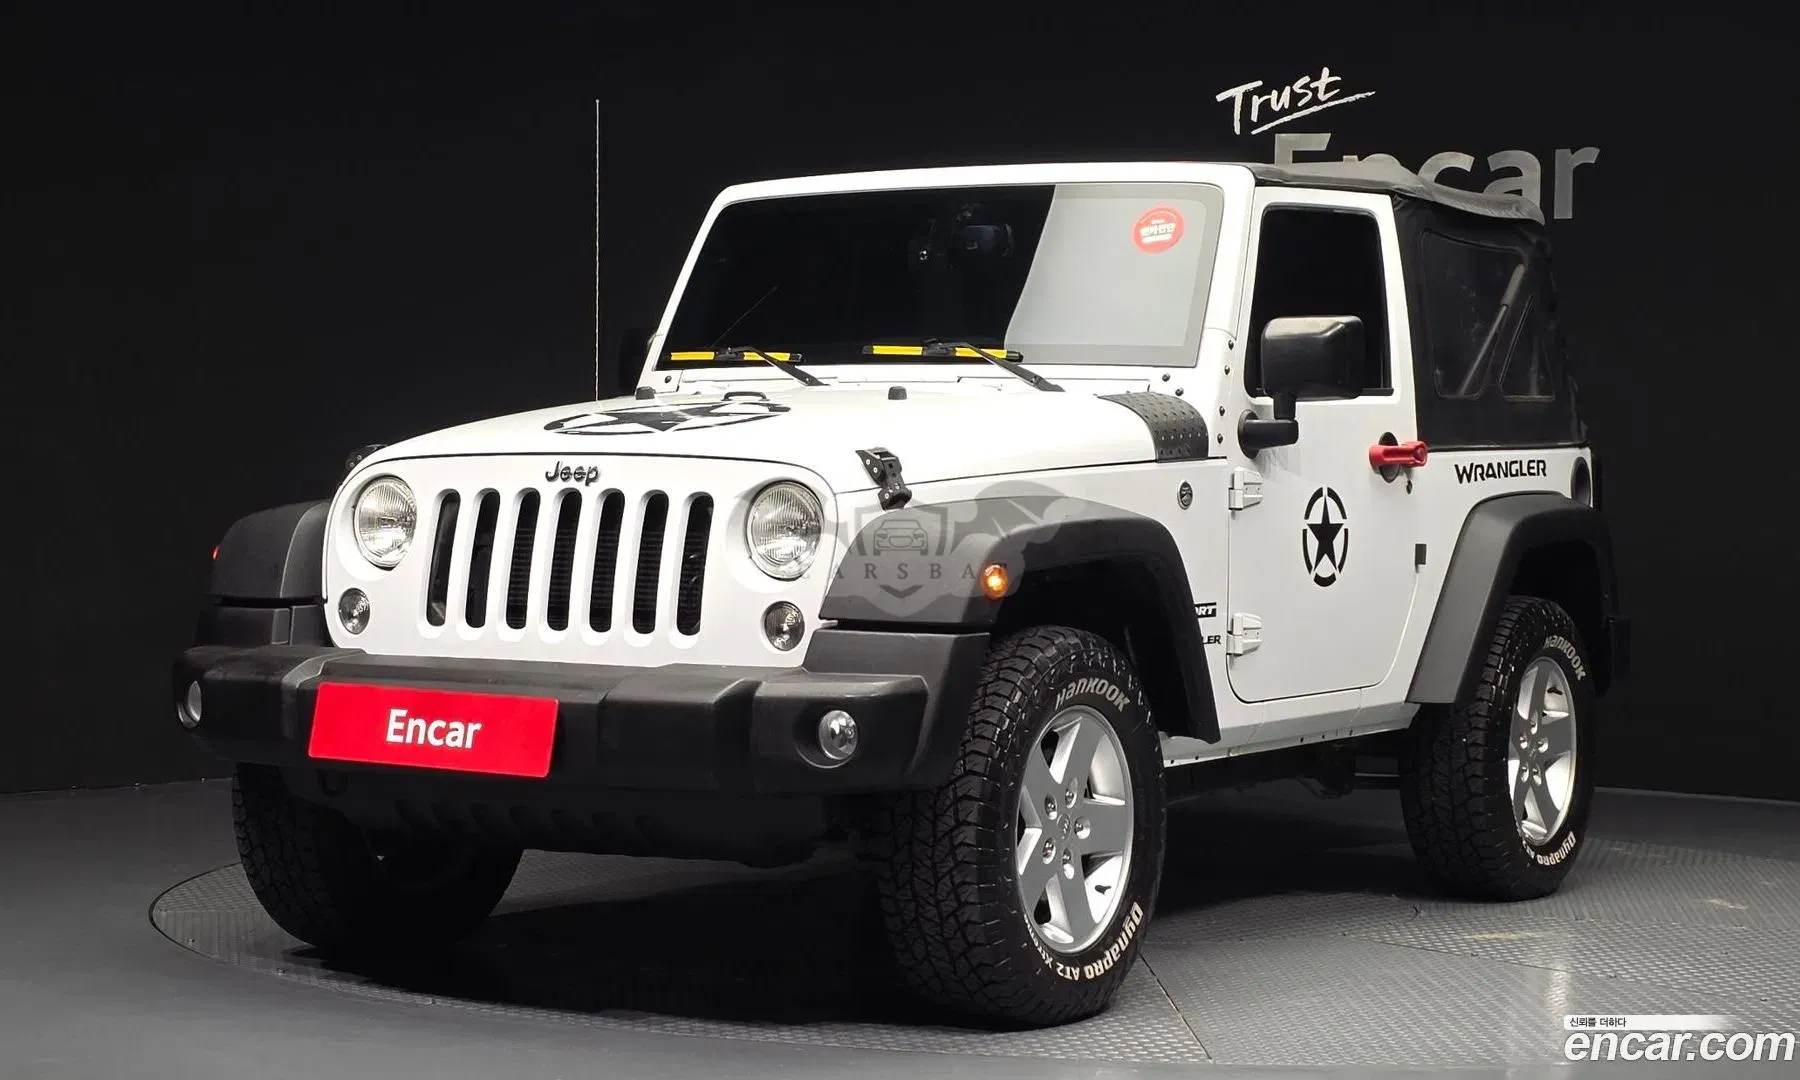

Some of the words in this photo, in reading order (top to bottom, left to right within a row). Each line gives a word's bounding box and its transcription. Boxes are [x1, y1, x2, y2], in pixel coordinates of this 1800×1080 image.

[1216, 67, 1341, 135] Trust
[1274, 133, 1600, 219] car
[545, 461, 600, 486] Jeep
[1454, 459, 1547, 484] WRANGLER
[386, 708, 483, 749] Encar
